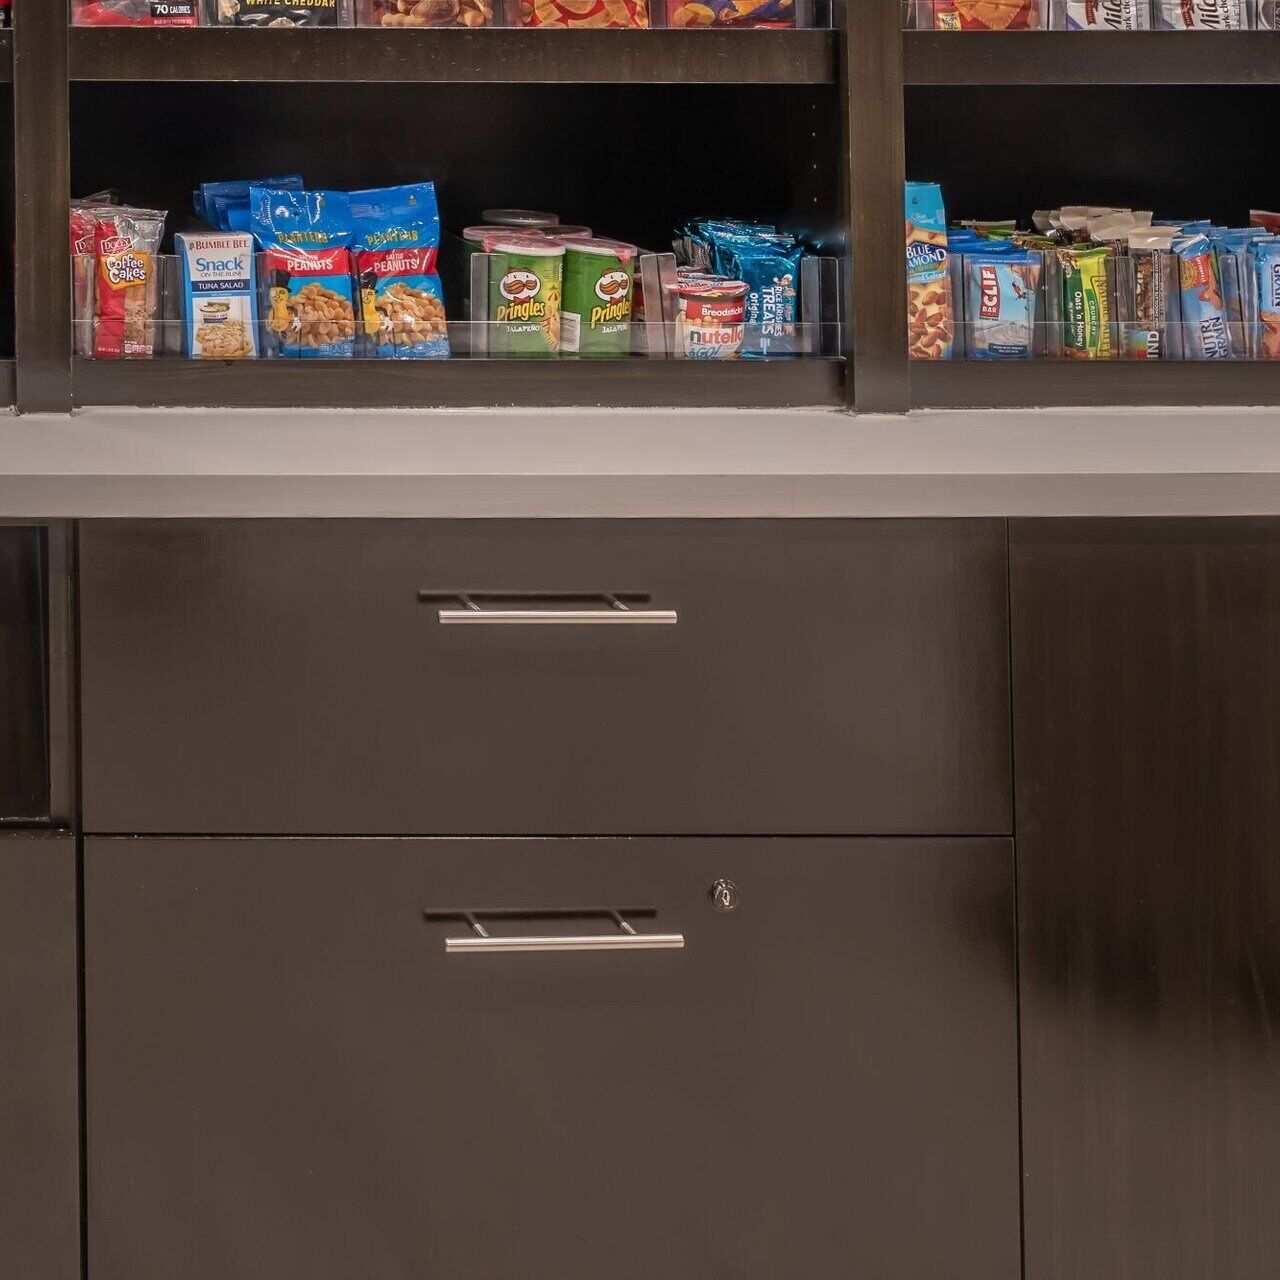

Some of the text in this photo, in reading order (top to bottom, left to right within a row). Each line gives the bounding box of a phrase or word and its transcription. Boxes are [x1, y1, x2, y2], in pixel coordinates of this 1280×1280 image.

[154, 4, 191, 15] 70 CALORIES
[195, 240, 249, 251] BUMBLE BEE
[906, 245, 932, 259] BLUE
[106, 254, 144, 272] Coffee
[194, 256, 243, 272] Snack
[286, 259, 334, 272] PEANUTS
[374, 260, 420, 272] PEANUTS
[108, 266, 146, 285] Cakes
[198, 281, 245, 291] TUNA SALAD
[982, 269, 998, 307] CLIF
[496, 297, 547, 328] Pringles
[701, 306, 744, 317] Breadsticks
[761, 287, 776, 335] TREATS
[982, 306, 998, 314] BAR
[774, 303, 786, 337] KRISPIES
[1074, 290, 1085, 347] Oats Honey
[1088, 299, 1098, 337] CRUNCHY
[506, 325, 541, 335] JALAPEÑO
